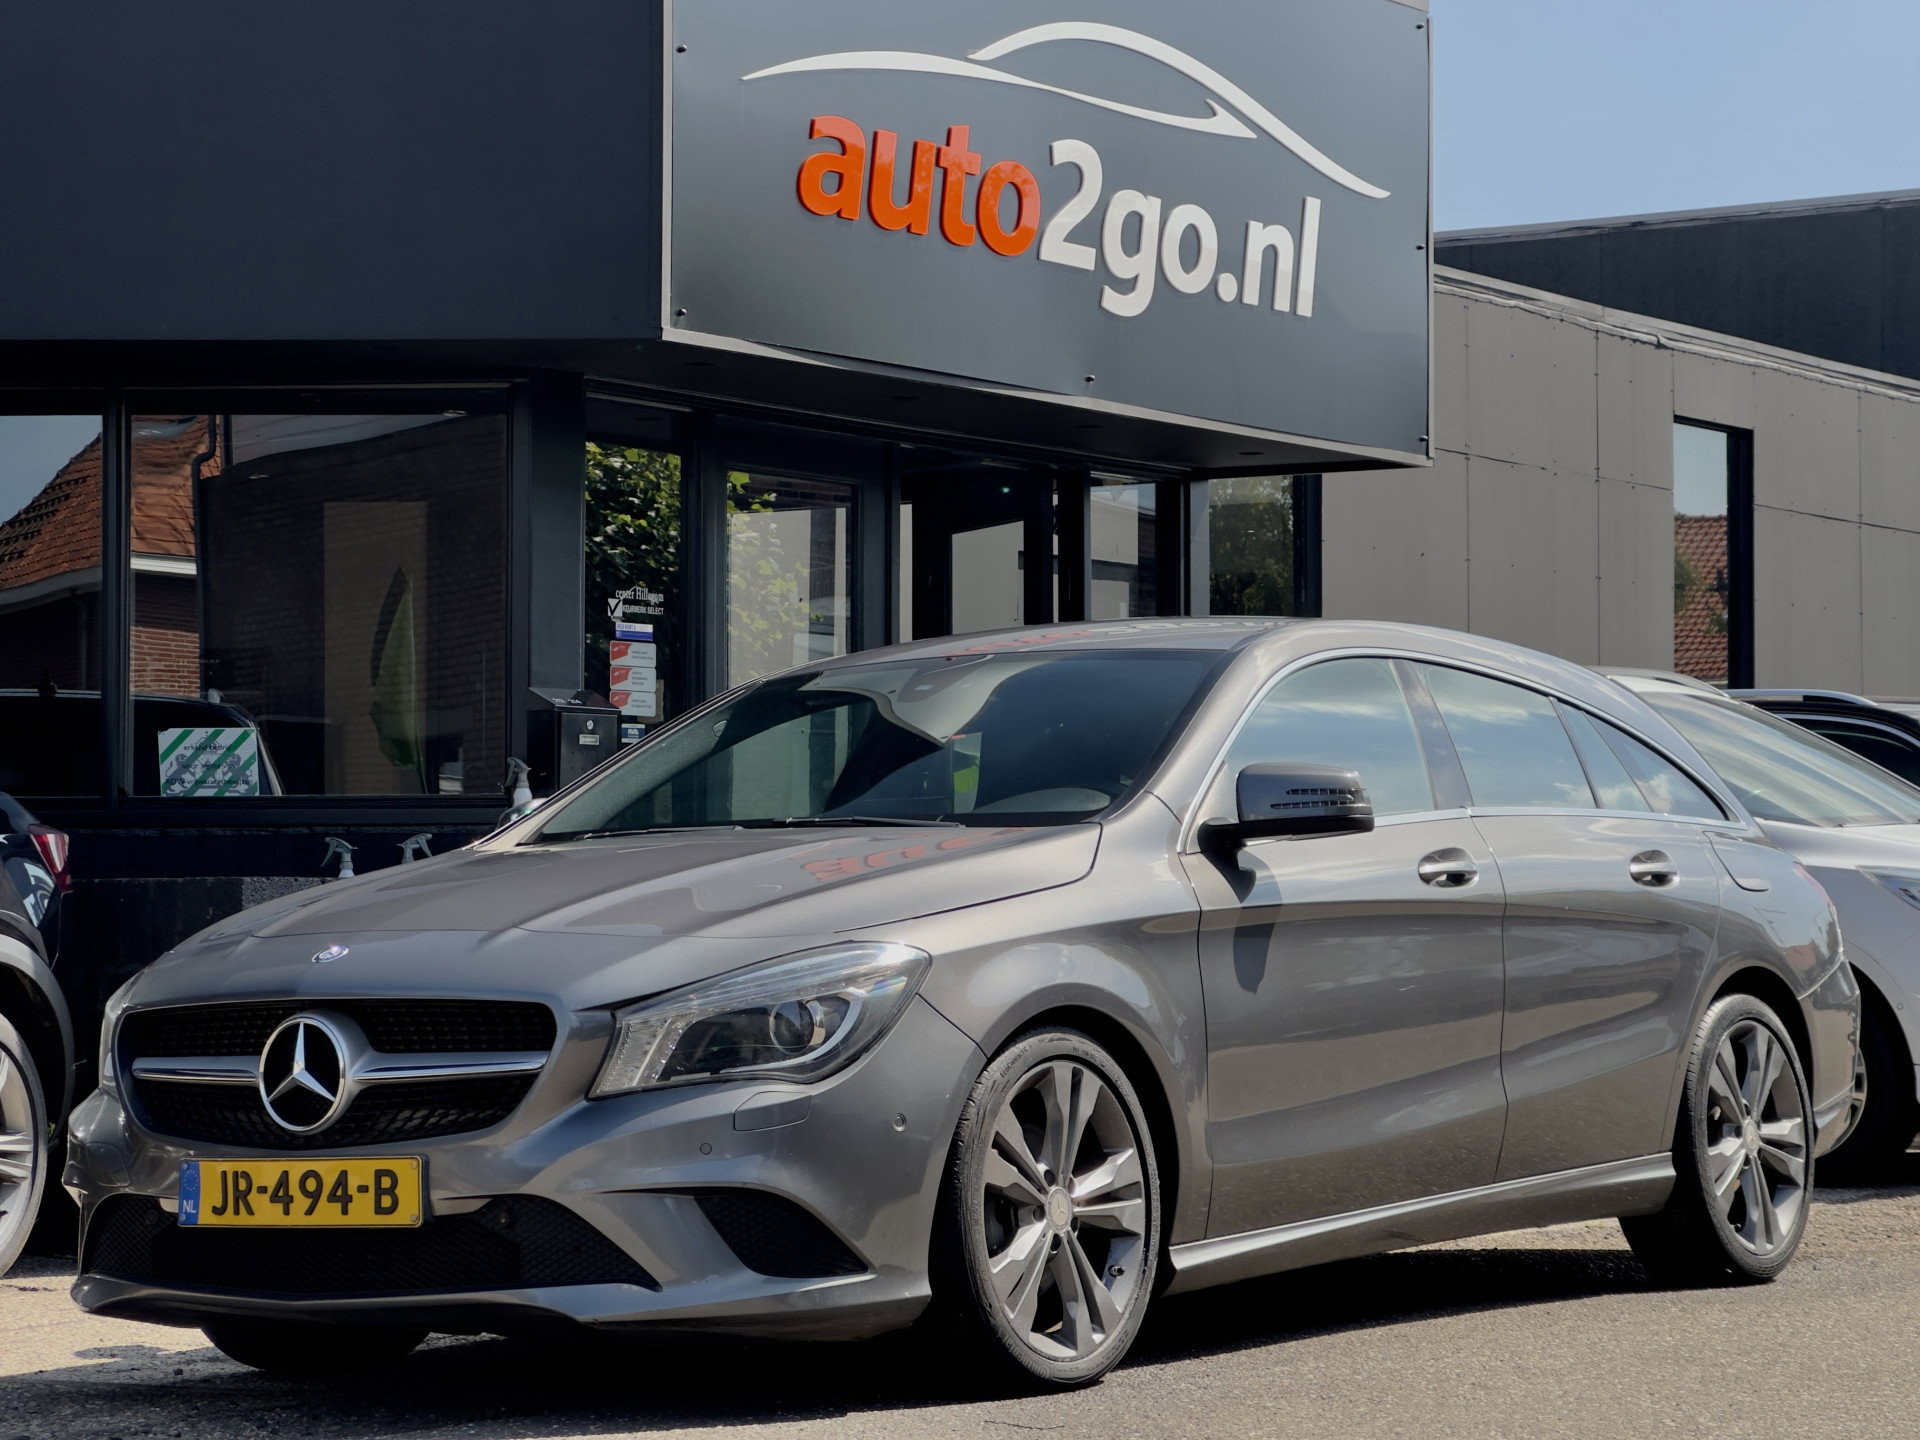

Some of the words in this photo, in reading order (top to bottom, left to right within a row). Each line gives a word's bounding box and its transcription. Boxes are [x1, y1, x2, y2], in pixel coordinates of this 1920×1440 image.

[797, 115, 1321, 318] auto2go.nl
[647, 607, 664, 615] SELECT
[183, 1200, 196, 1213] NL
[211, 1170, 399, 1216] JR-494-B
